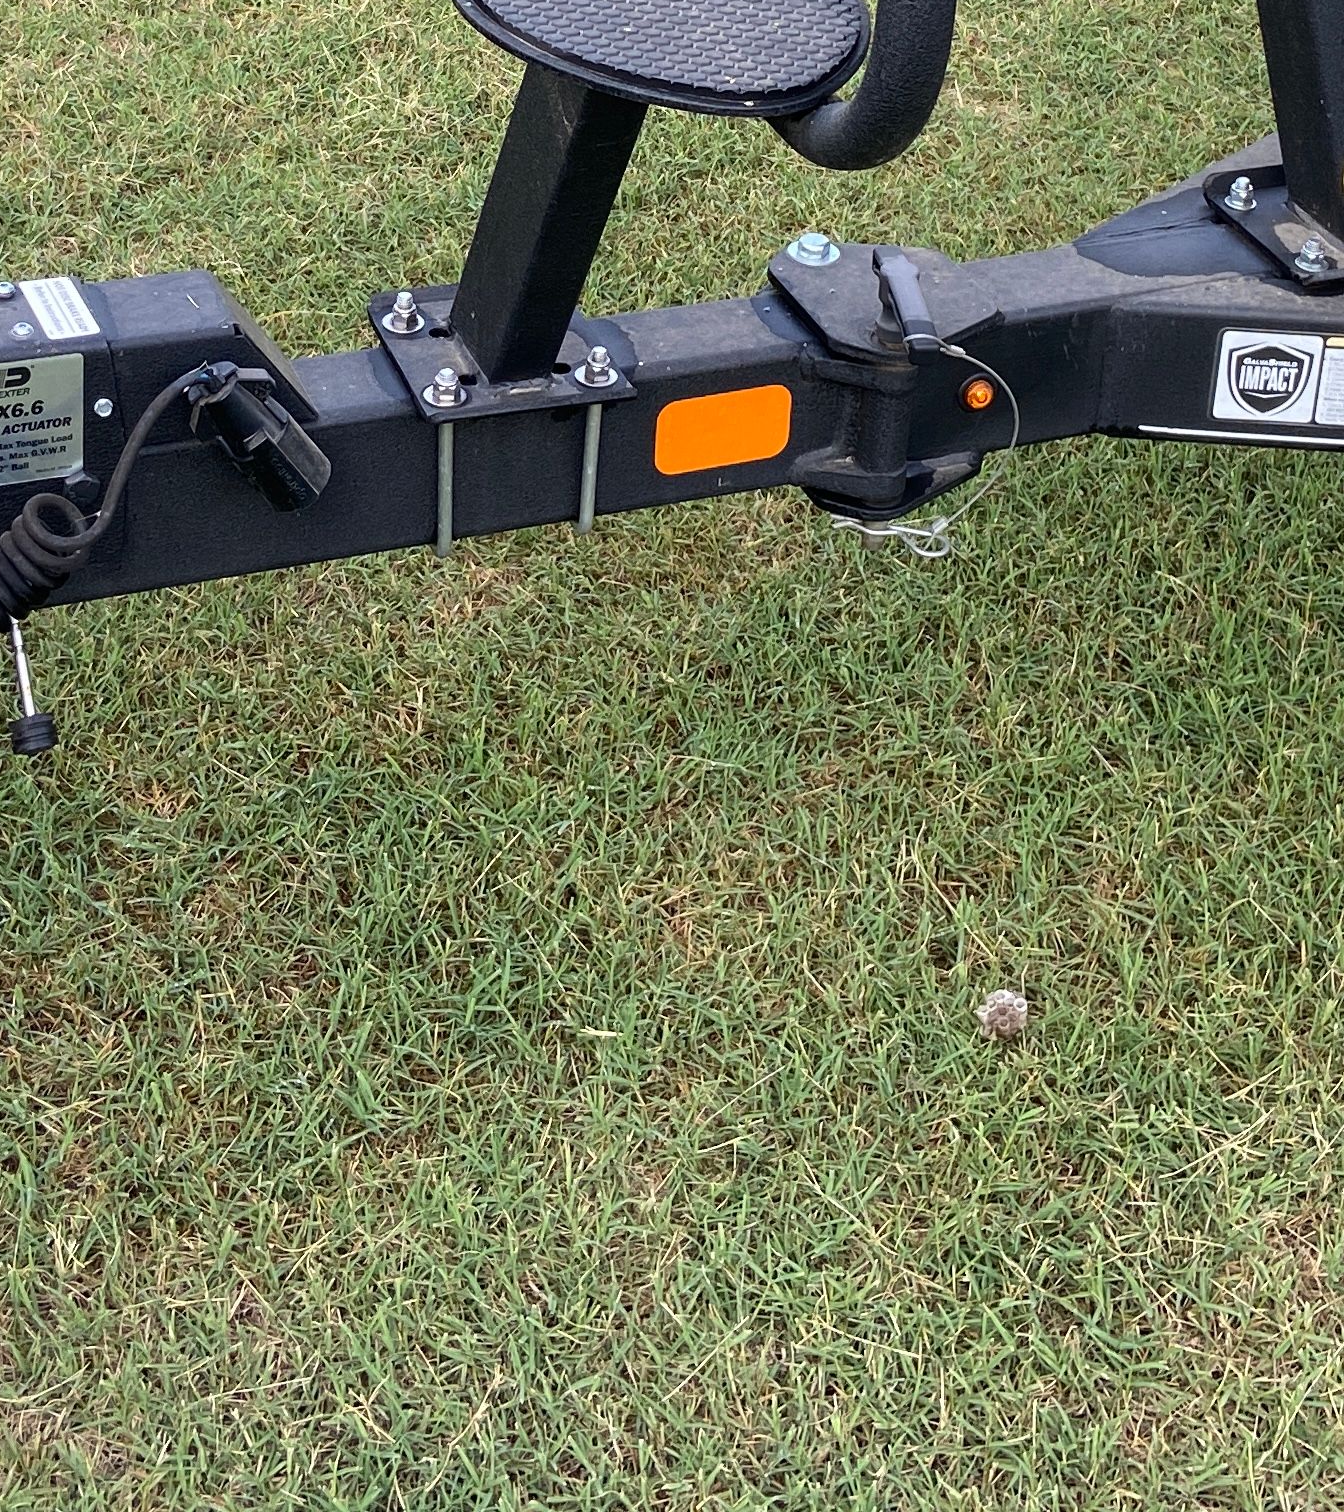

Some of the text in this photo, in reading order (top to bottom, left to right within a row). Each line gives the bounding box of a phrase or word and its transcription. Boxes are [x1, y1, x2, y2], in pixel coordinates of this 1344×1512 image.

[1238, 364, 1299, 393] IMPACT
[1, 416, 72, 436] ACTUATOR
[15, 437, 49, 448] Tongue
[51, 433, 73, 443] Load
[9, 450, 29, 461] Max
[11, 461, 30, 472] Ball
